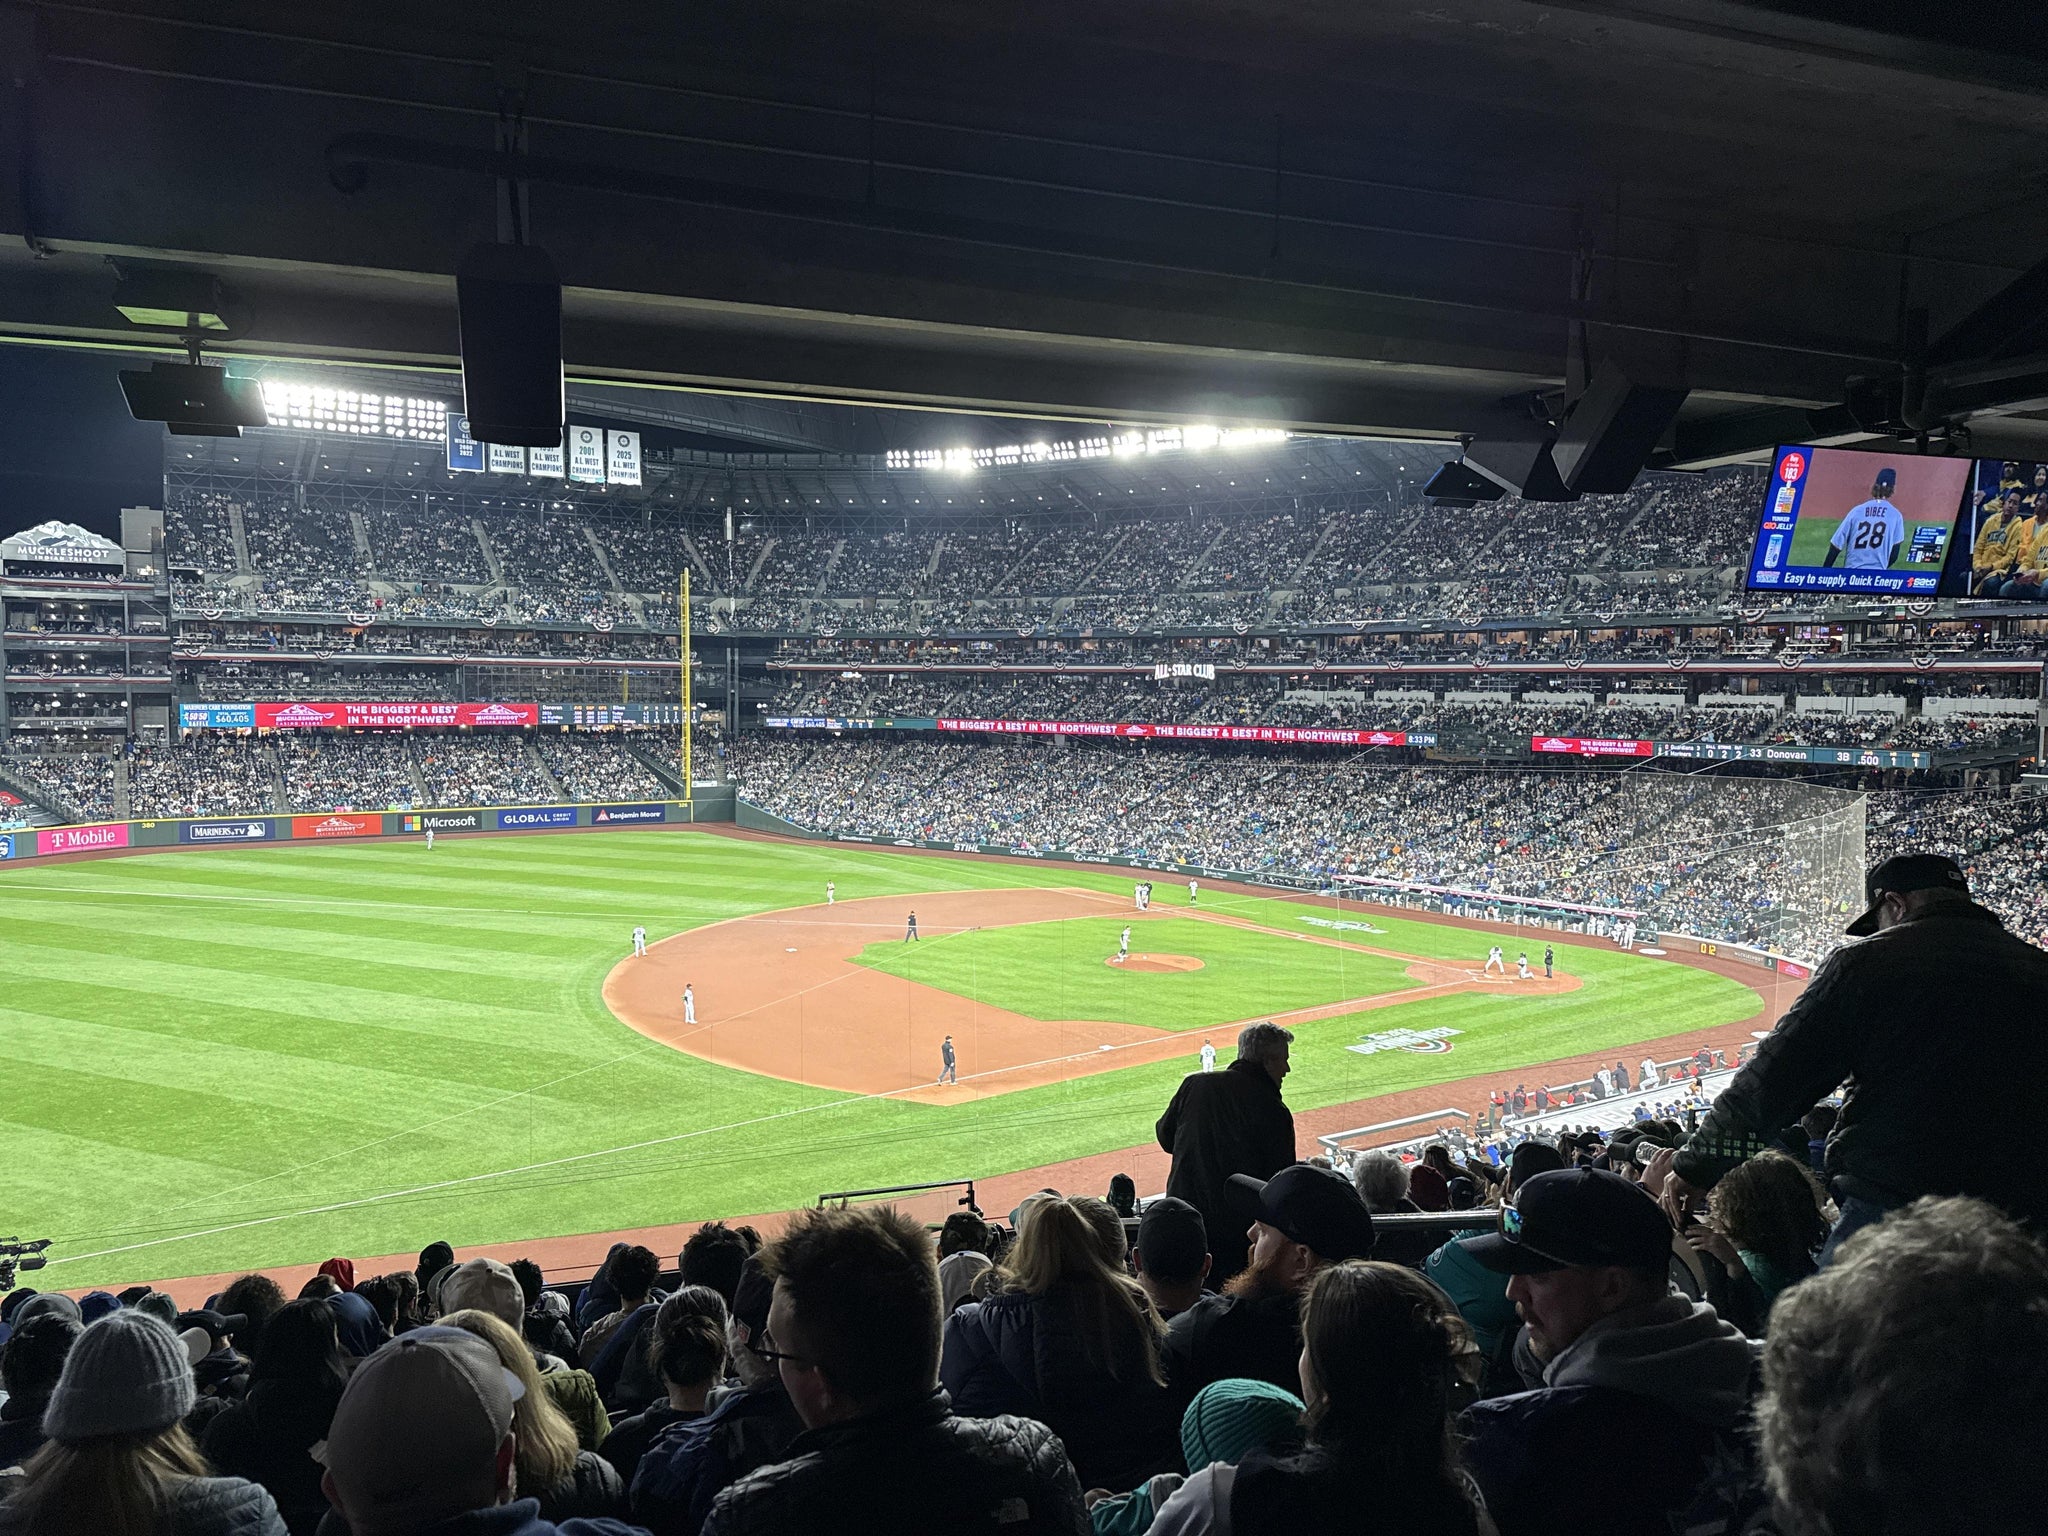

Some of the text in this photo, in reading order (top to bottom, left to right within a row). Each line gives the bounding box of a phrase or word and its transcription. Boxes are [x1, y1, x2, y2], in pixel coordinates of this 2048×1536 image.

[494, 449, 520, 458] A.L. WEST
[579, 446, 595, 456] 2001
[616, 450, 632, 460] 2025
[534, 453, 560, 462] A.L. WEST
[574, 457, 599, 466] A.L. WEST
[492, 459, 524, 470] CHAMPIONS
[532, 463, 562, 473] CHAMPIONS
[622, 462, 636, 470] WEST
[572, 466, 602, 476] CHAMPIONS
[610, 470, 638, 480] CHAMPIONS
[1784, 468, 1798, 480] 183
[1864, 506, 1887, 518] BIBEE
[1854, 520, 1887, 550] 28
[17, 546, 110, 558] MUCKLESHOOT
[1784, 572, 1904, 590] Easy to supply. Quick Energy
[1914, 578, 1936, 586] sato
[1193, 664, 1216, 680] CLUB
[346, 706, 458, 714] THE BIGGEST & BEST
[348, 716, 455, 724] IN THE NORTHWEST
[942, 720, 1117, 734] THE BIGGEST & BEST IN THE NORTHWEST
[1155, 726, 1174, 735] THE
[1176, 727, 1220, 736] BIGGEST
[1222, 728, 1229, 737] &
[1232, 728, 1258, 738] BEST
[1261, 729, 1272, 738] IN
[1276, 730, 1295, 739] THE
[1298, 731, 1360, 742] NORTHWEST
[1408, 736, 1435, 744] 8:33 PM
[1708, 750, 1742, 760] 0 2 2
[1750, 748, 1850, 762] 33 Donovan 3B
[1858, 756, 1918, 767] .500 1 1
[504, 814, 550, 824] GLOBAL
[610, 812, 639, 820] Benjamin
[424, 816, 476, 828] Microsoft
[68, 829, 116, 846] Mobile
[195, 828, 246, 837] MARINERS.TV
[954, 842, 981, 853] STIHL
[1010, 848, 1044, 858] Great Clips
[1708, 944, 1716, 956] 12
